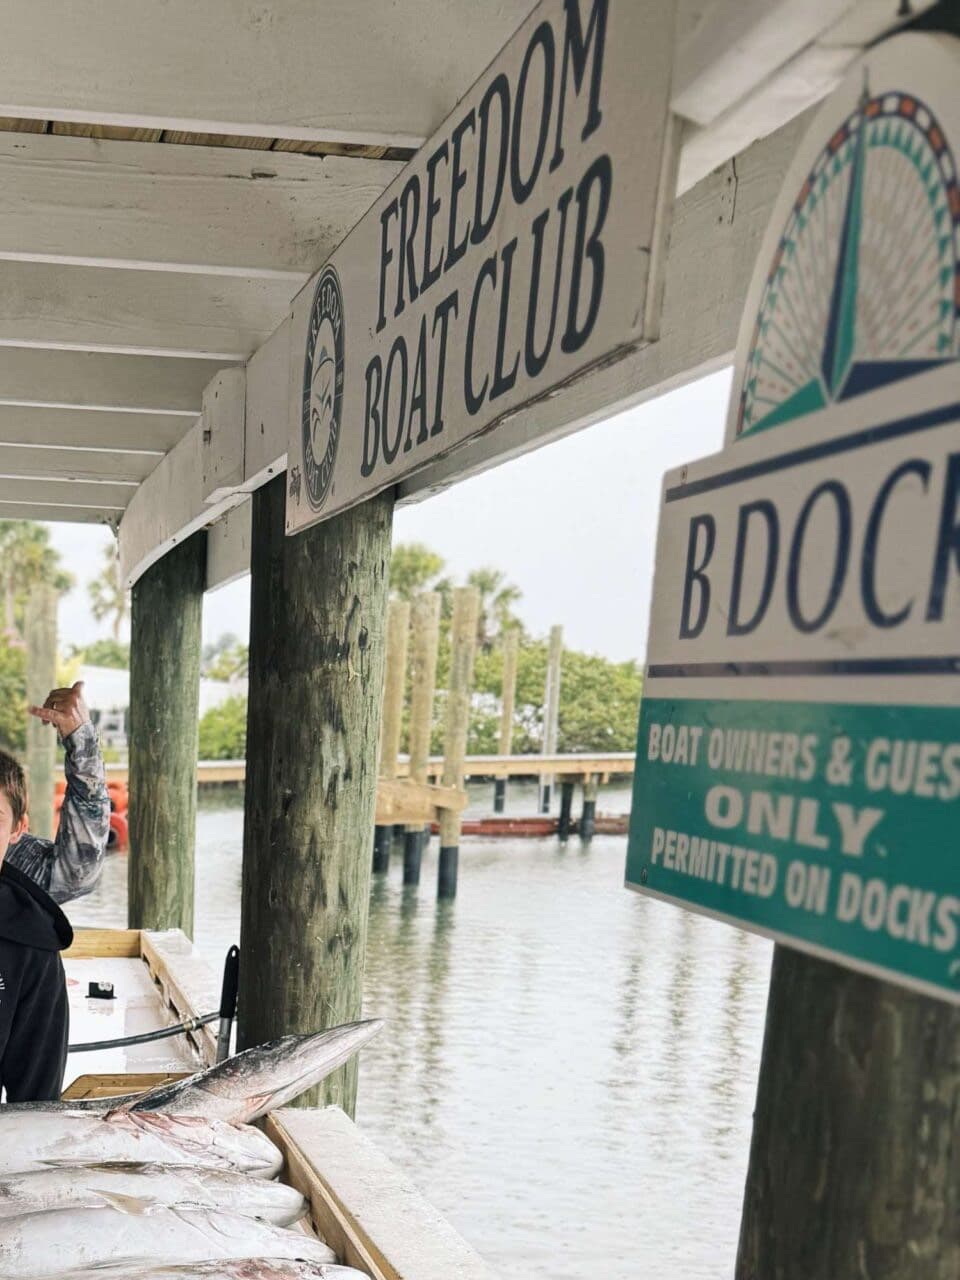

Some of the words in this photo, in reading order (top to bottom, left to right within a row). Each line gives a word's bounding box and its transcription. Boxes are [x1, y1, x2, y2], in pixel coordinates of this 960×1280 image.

[374, 0, 610, 333] FREEDOM
[359, 290, 458, 479] BOAT
[463, 154, 614, 416] CLUB
[678, 512, 717, 641] B
[648, 722, 703, 766] BOAT
[707, 727, 819, 783] OWNERS
[825, 736, 854, 787] &
[704, 784, 886, 858] ONLY
[651, 826, 778, 898] PERMITTED
[784, 859, 831, 916] ON
[836, 872, 960, 952] DOCKS
